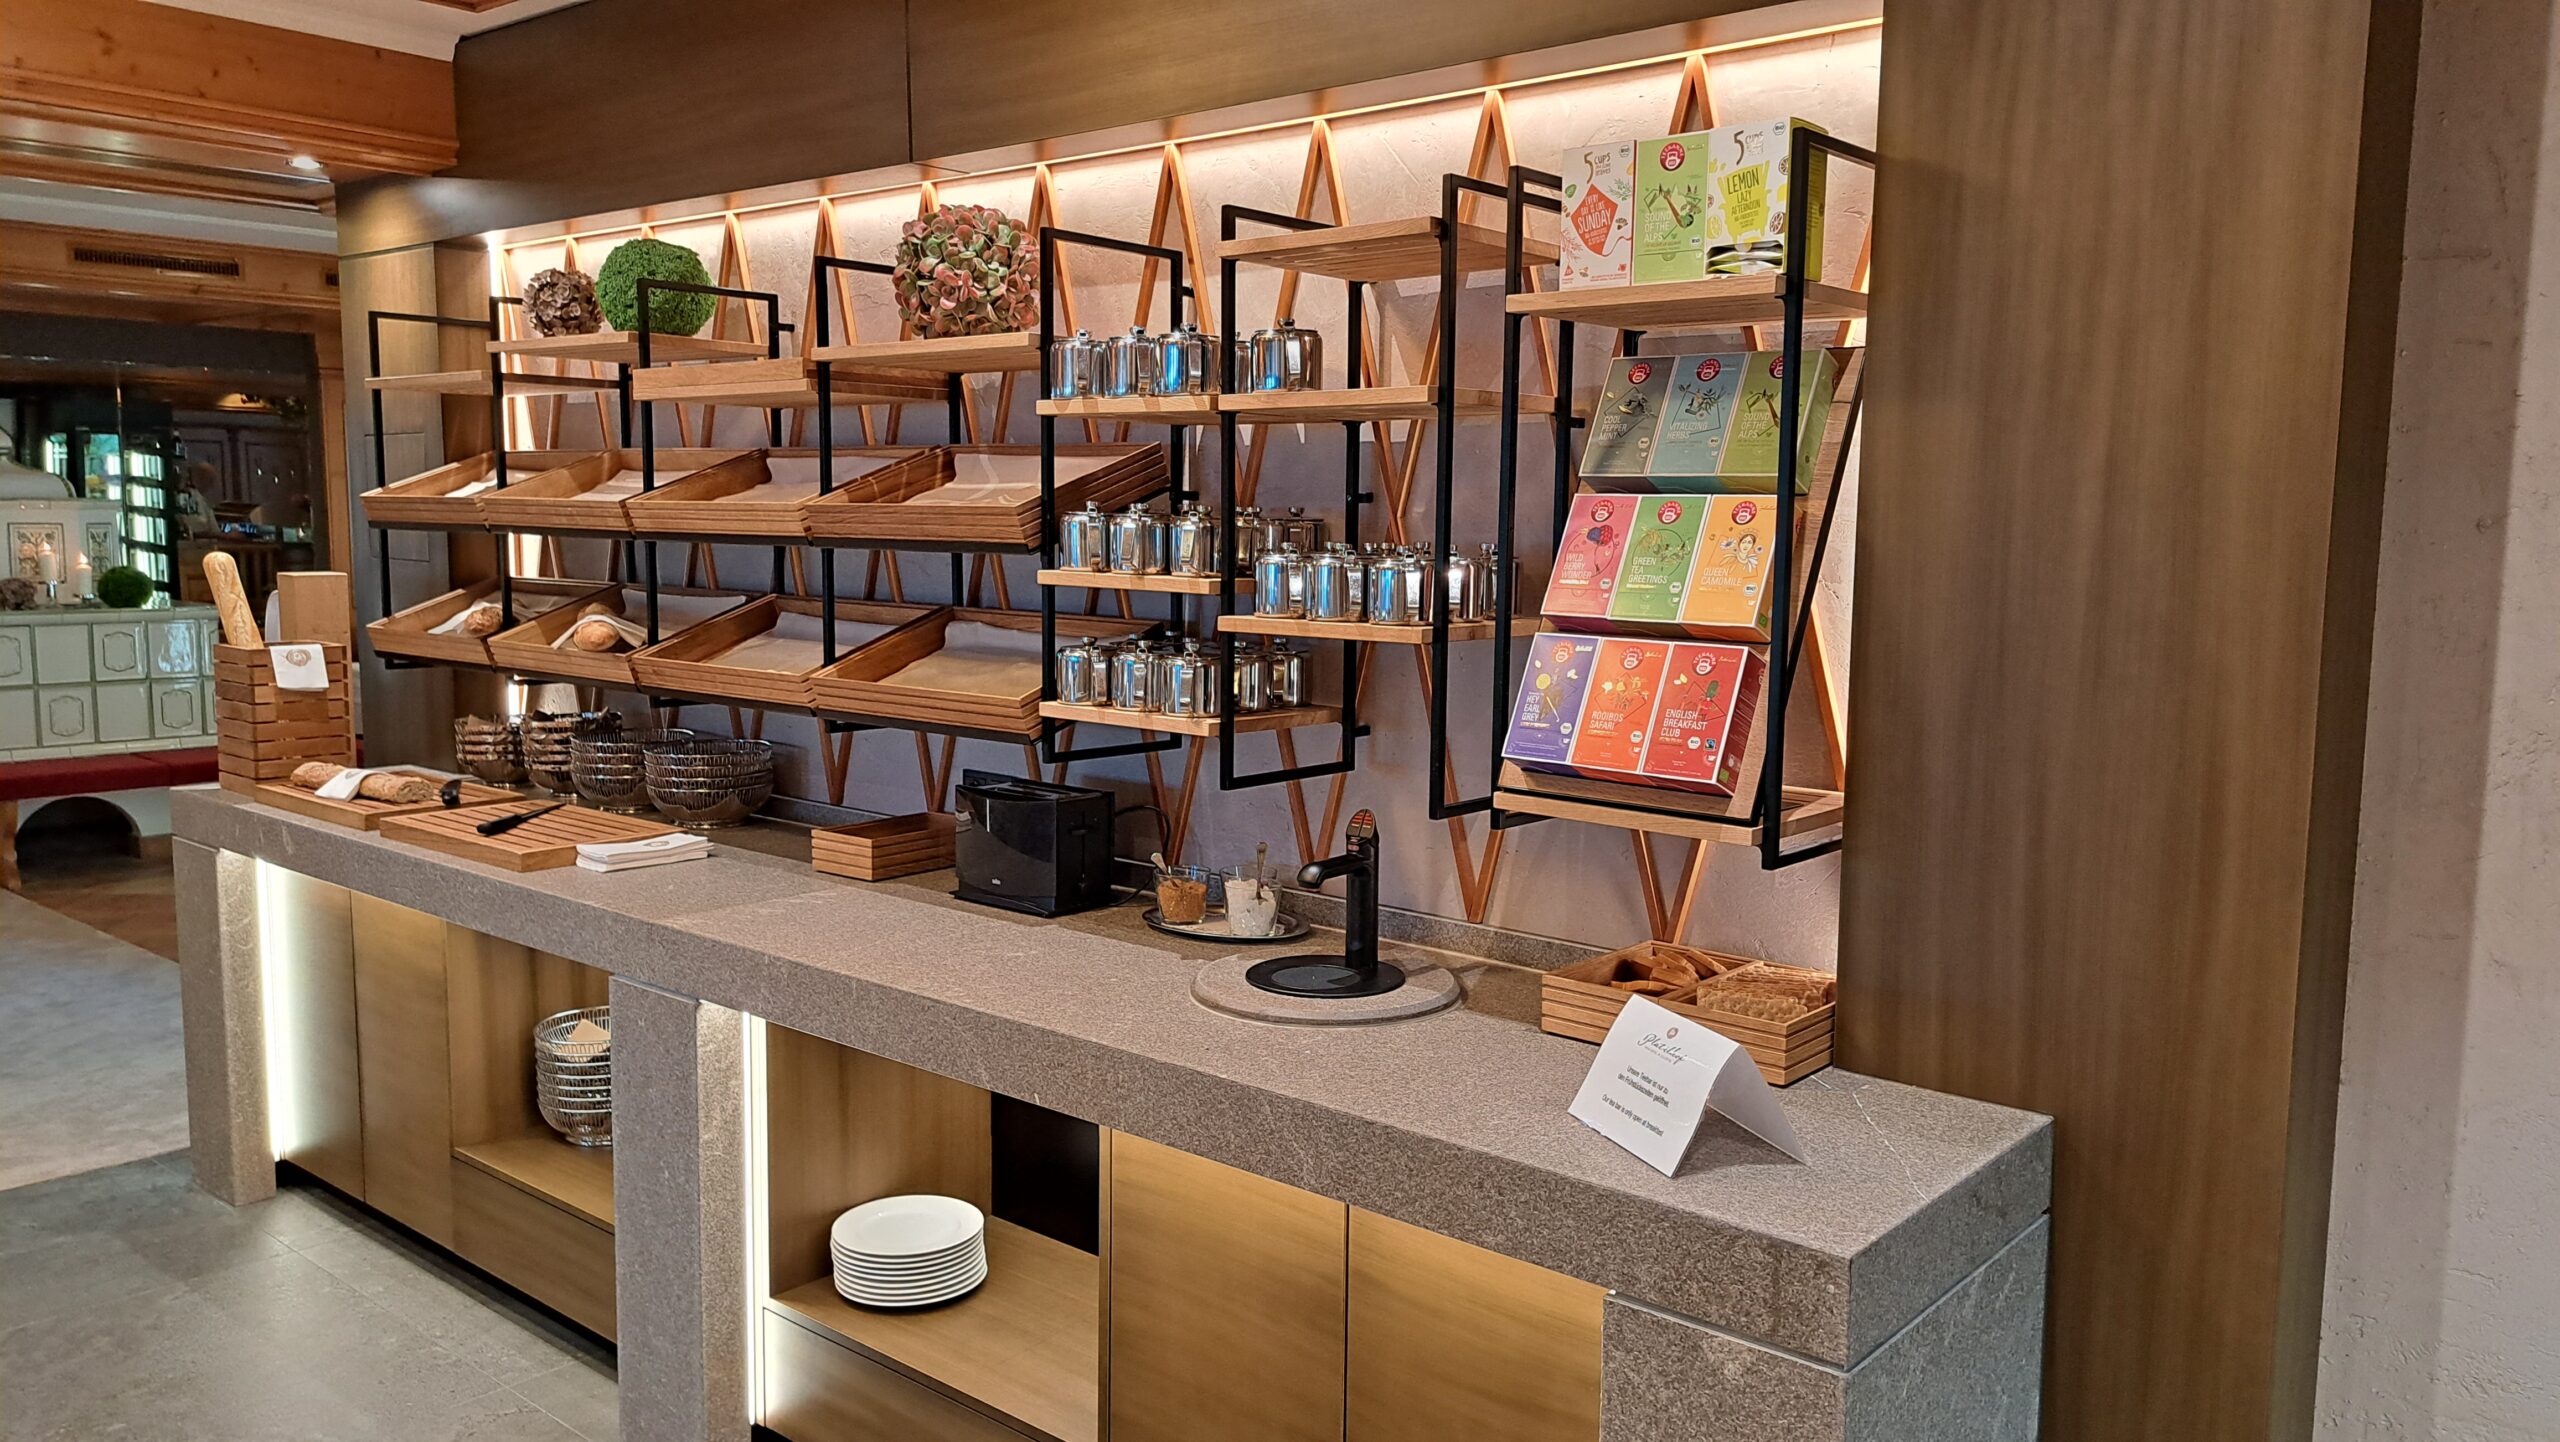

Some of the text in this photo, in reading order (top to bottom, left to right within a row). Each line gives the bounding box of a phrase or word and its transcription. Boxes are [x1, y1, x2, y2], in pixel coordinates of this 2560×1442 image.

[1734, 130, 1744, 165] 5
[1584, 151, 1611, 184] 5 CUPS
[1727, 168, 1760, 195] LEMON
[1737, 190, 1752, 203] LAZY
[1732, 199, 1761, 216] AFTERNOON
[1578, 208, 1611, 233] SUNDAY
[1645, 211, 1671, 223] SOUND
[1645, 221, 1671, 232] OF THE
[1644, 232, 1663, 241] ALPS
[1604, 416, 1621, 424] COOL
[1744, 412, 1769, 421] SOUND
[1602, 423, 1628, 432] PEPPER
[1670, 422, 1708, 431] VITALIZING
[1741, 421, 1767, 430] OF THE
[1599, 432, 1618, 440] MINT
[1667, 431, 1691, 439] HERBS
[1738, 430, 1758, 439] ALPS
[1567, 553, 1584, 561] WILD
[1632, 556, 1657, 565] GREEN
[1563, 561, 1585, 570] BERRY
[1631, 566, 1644, 574] TEA
[1561, 570, 1592, 579] WONDER
[1704, 568, 1729, 577] QUEEN
[1628, 574, 1668, 584] GREETINGS
[1701, 576, 1742, 586] CAMOMILE
[1526, 695, 1540, 704] HEY
[1523, 703, 1540, 713] EARL
[1521, 712, 1539, 722] GREY
[1591, 711, 1624, 722] ROOIBOS
[1665, 708, 1699, 720] ENGLISH
[1589, 720, 1615, 731] SAFARI
[1663, 718, 1708, 731] BREAKFAST
[1660, 727, 1681, 738] CLUB
[1602, 1094, 1610, 1103] Our
